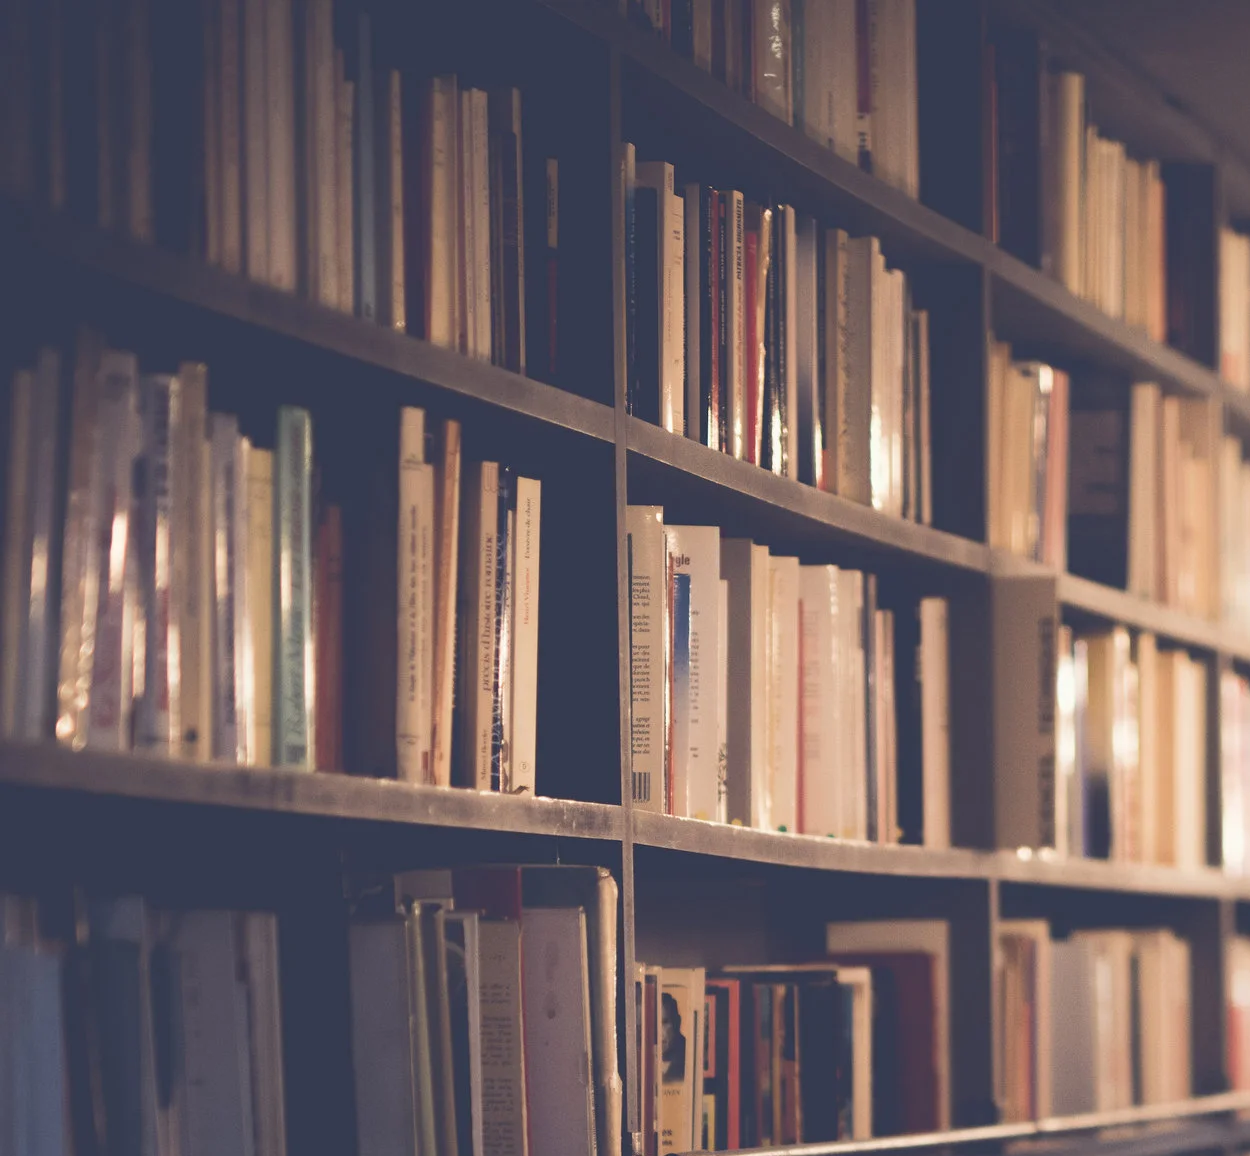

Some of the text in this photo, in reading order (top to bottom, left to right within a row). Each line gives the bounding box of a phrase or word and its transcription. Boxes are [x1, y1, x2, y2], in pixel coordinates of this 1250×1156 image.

[484, 536, 493, 589] romaine
[674, 554, 690, 567] gle
[480, 655, 491, 692] précis
